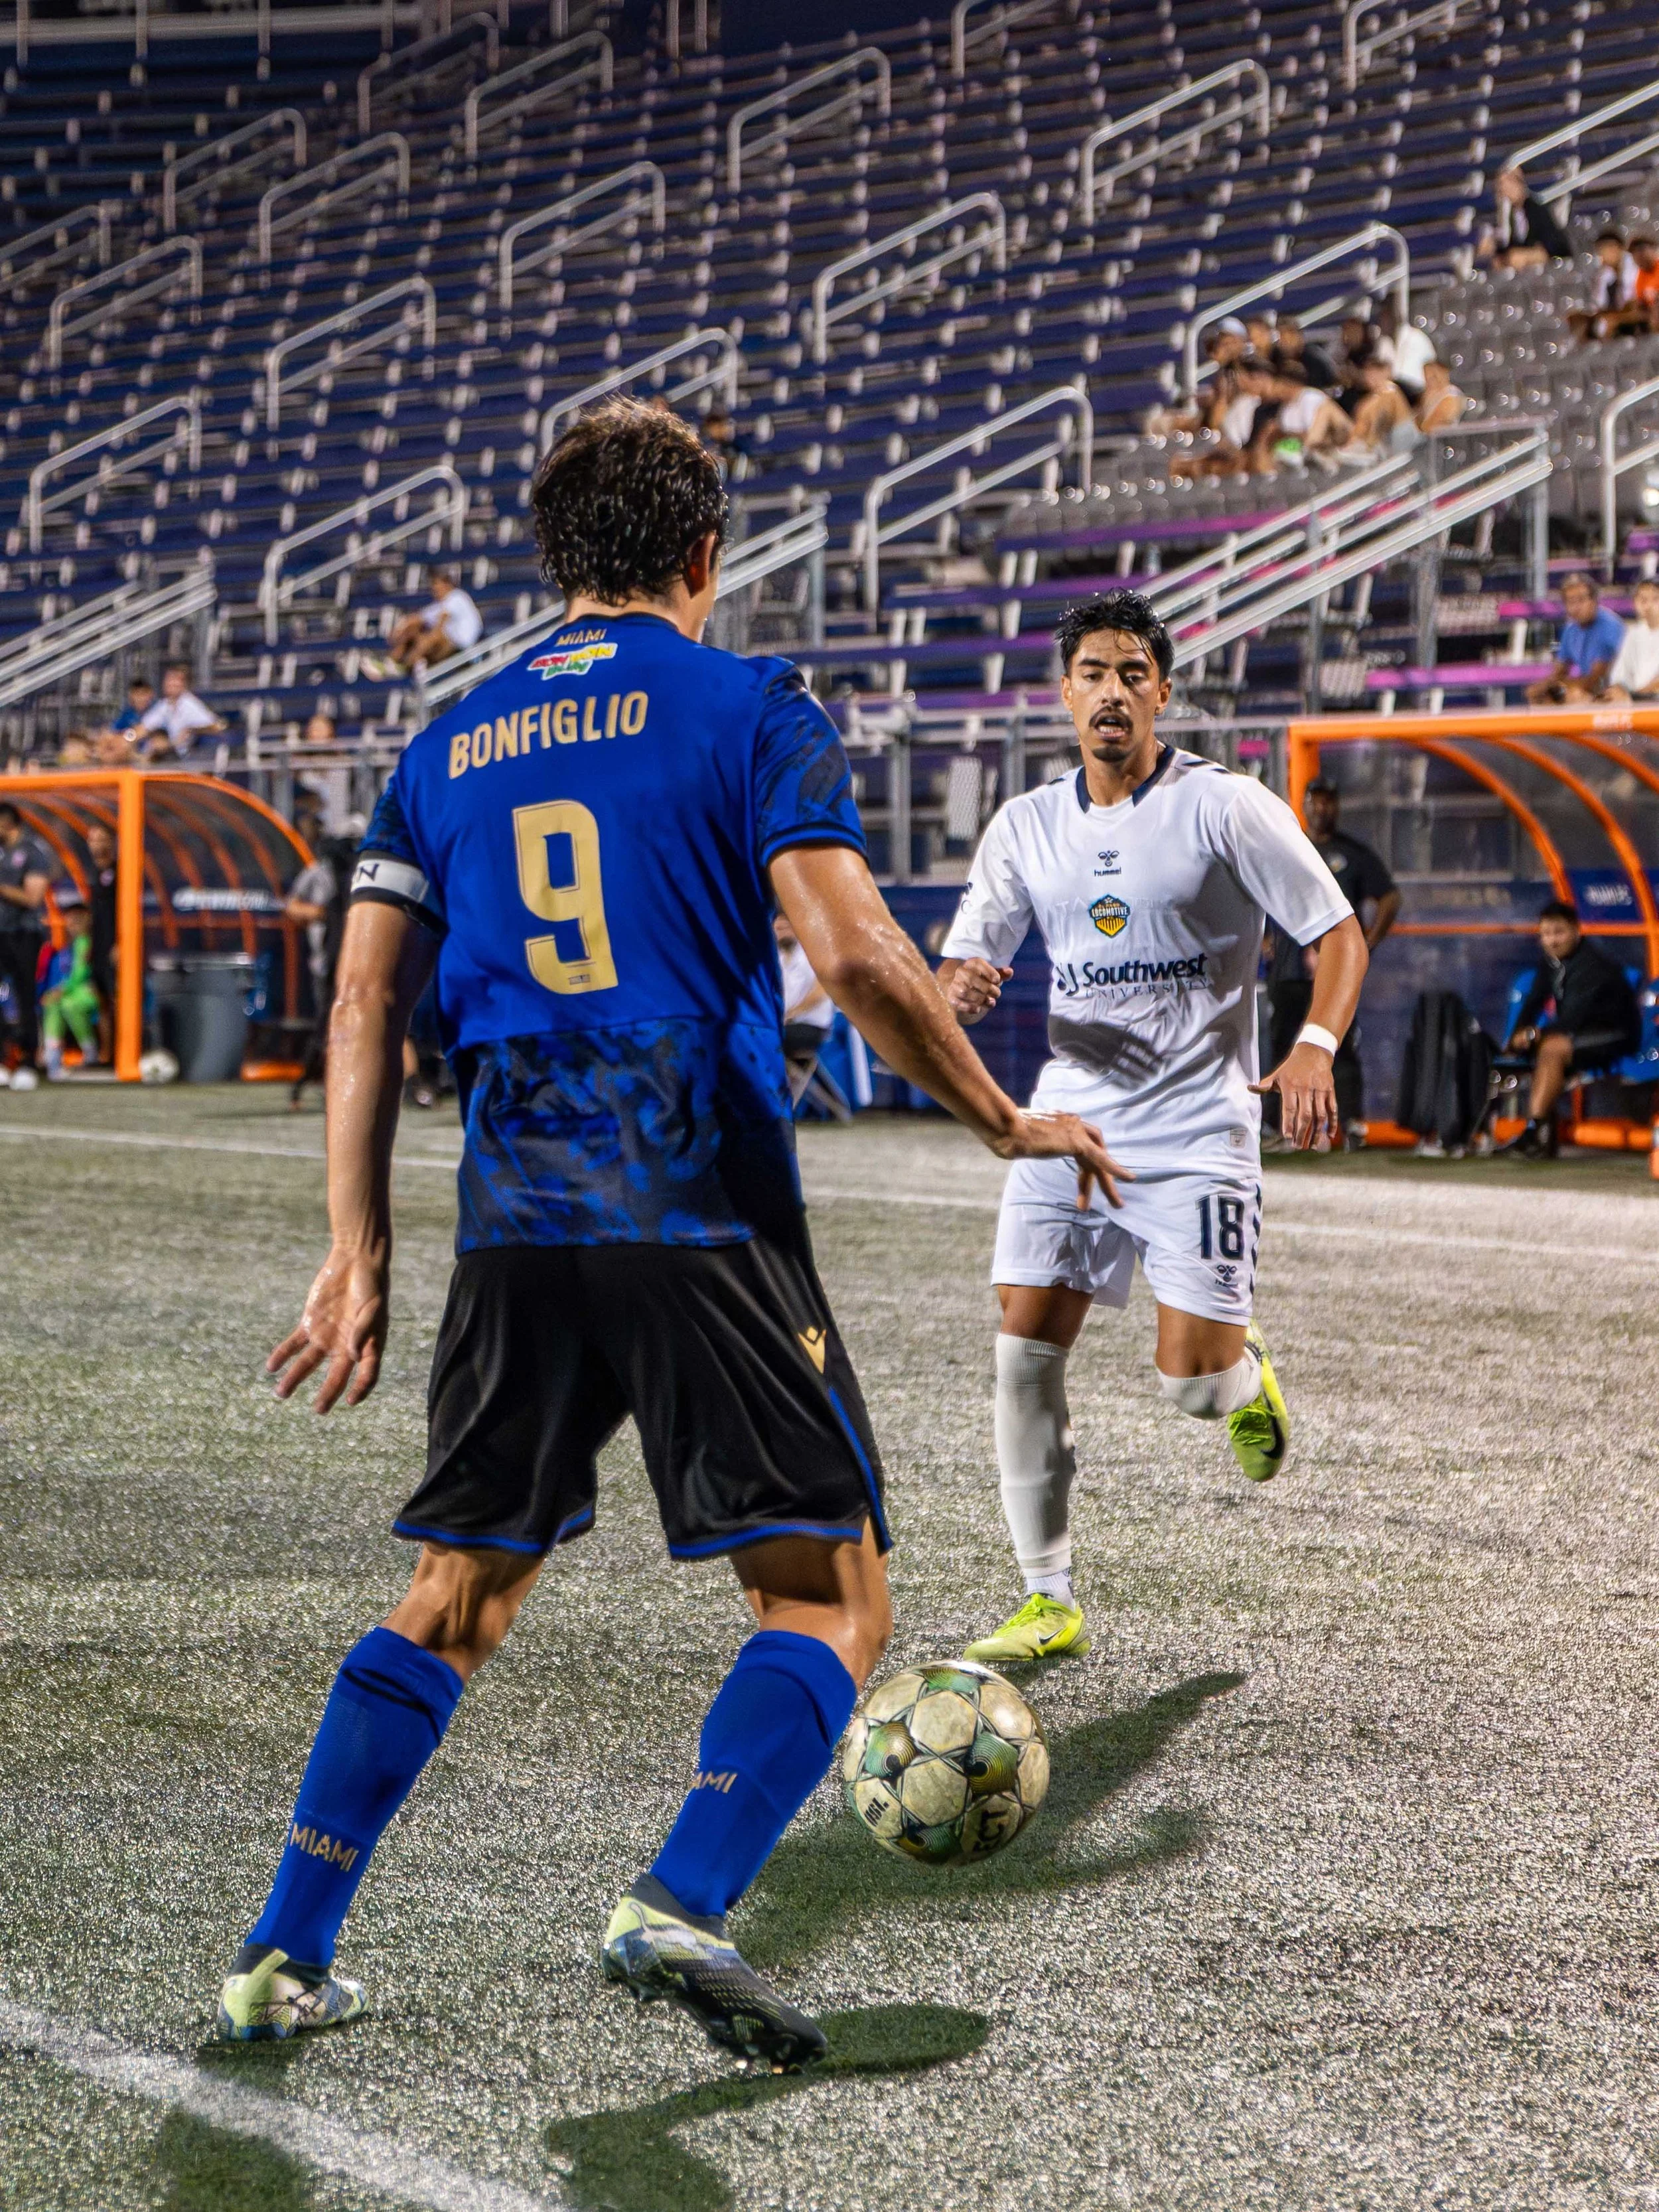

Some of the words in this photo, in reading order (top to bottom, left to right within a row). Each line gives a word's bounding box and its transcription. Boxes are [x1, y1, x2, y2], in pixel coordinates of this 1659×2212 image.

[554, 628, 607, 646] MIAMI
[448, 691, 649, 780] BONFIGLIO
[1094, 867, 1121, 877] hummel
[512, 798, 618, 995] 9
[1091, 907, 1129, 917] LOCOMOTIVE
[1083, 954, 1207, 987] Southwest
[1086, 977, 1211, 998] UNIVERSITY
[1195, 1194, 1245, 1260] 18
[290, 1822, 359, 1872] MIAMI
